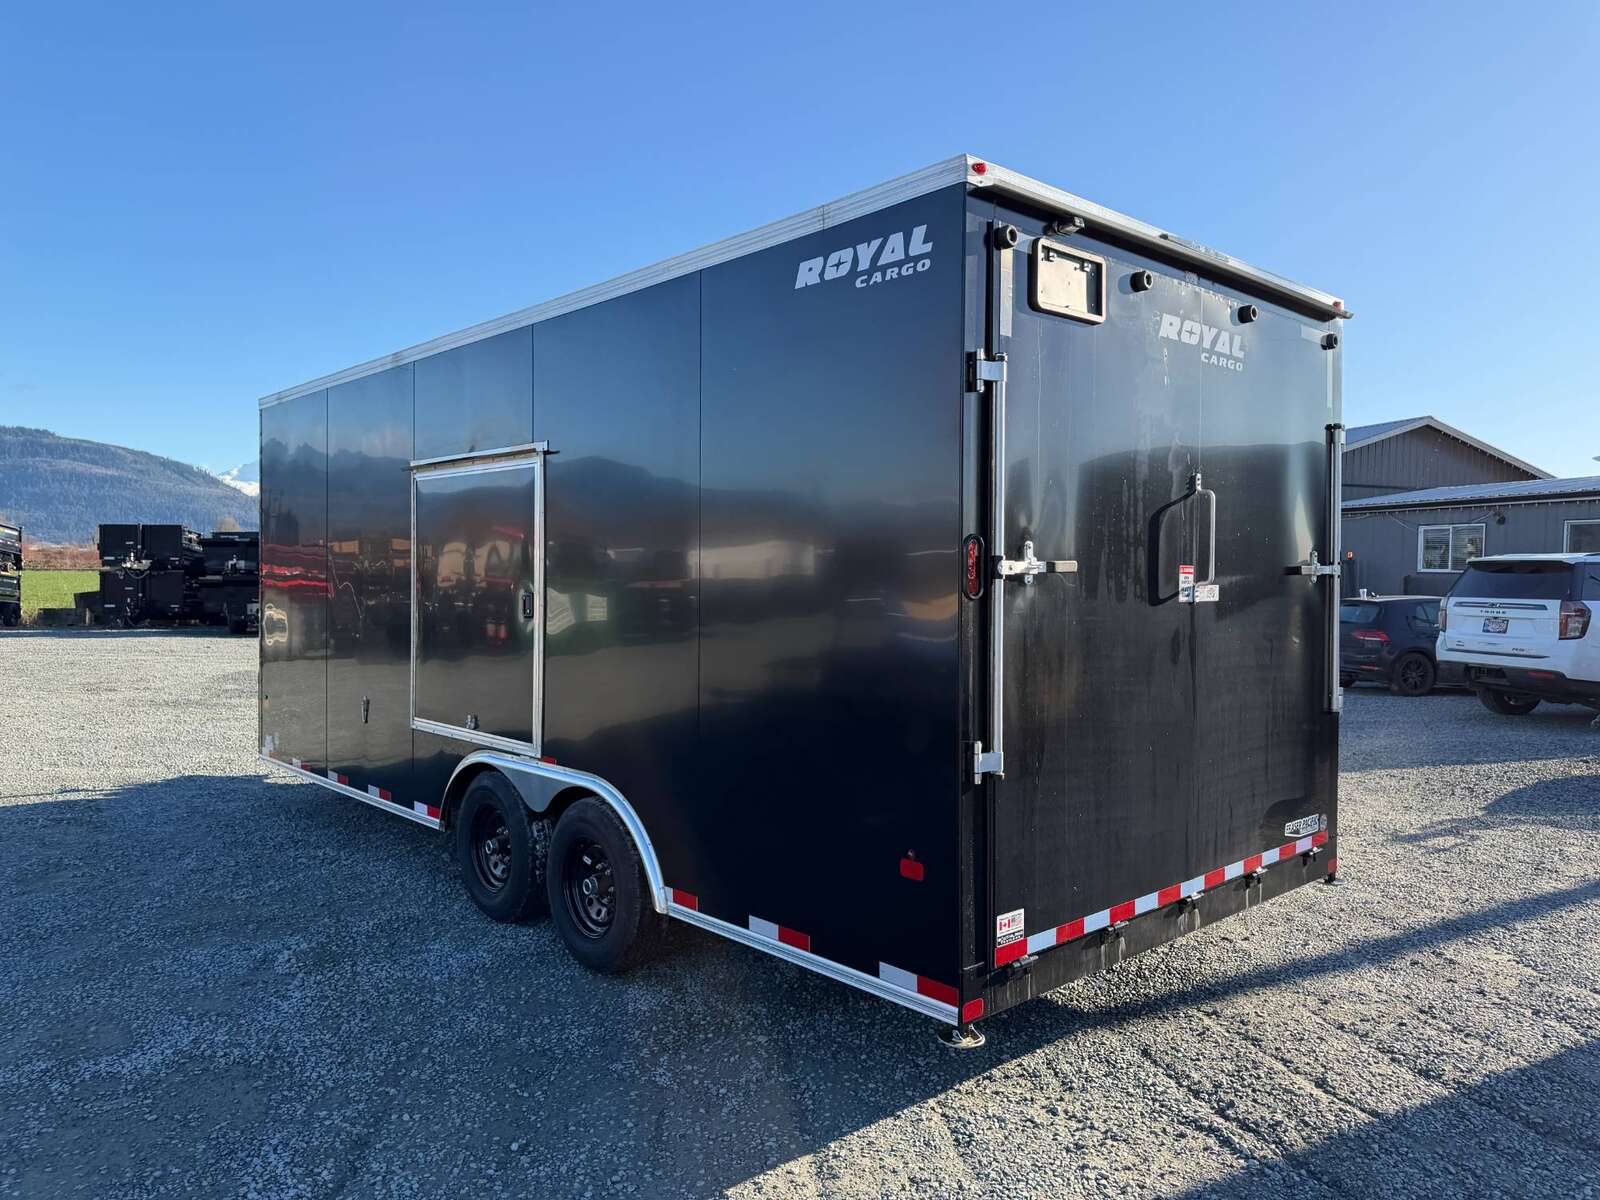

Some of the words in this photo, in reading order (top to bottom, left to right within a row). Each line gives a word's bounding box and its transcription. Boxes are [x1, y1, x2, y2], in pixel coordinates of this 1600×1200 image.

[795, 224, 933, 289] ROYAL
[855, 258, 931, 288] CARGO
[1159, 313, 1245, 359] ROYAL
[1200, 352, 1244, 372] CARGO
